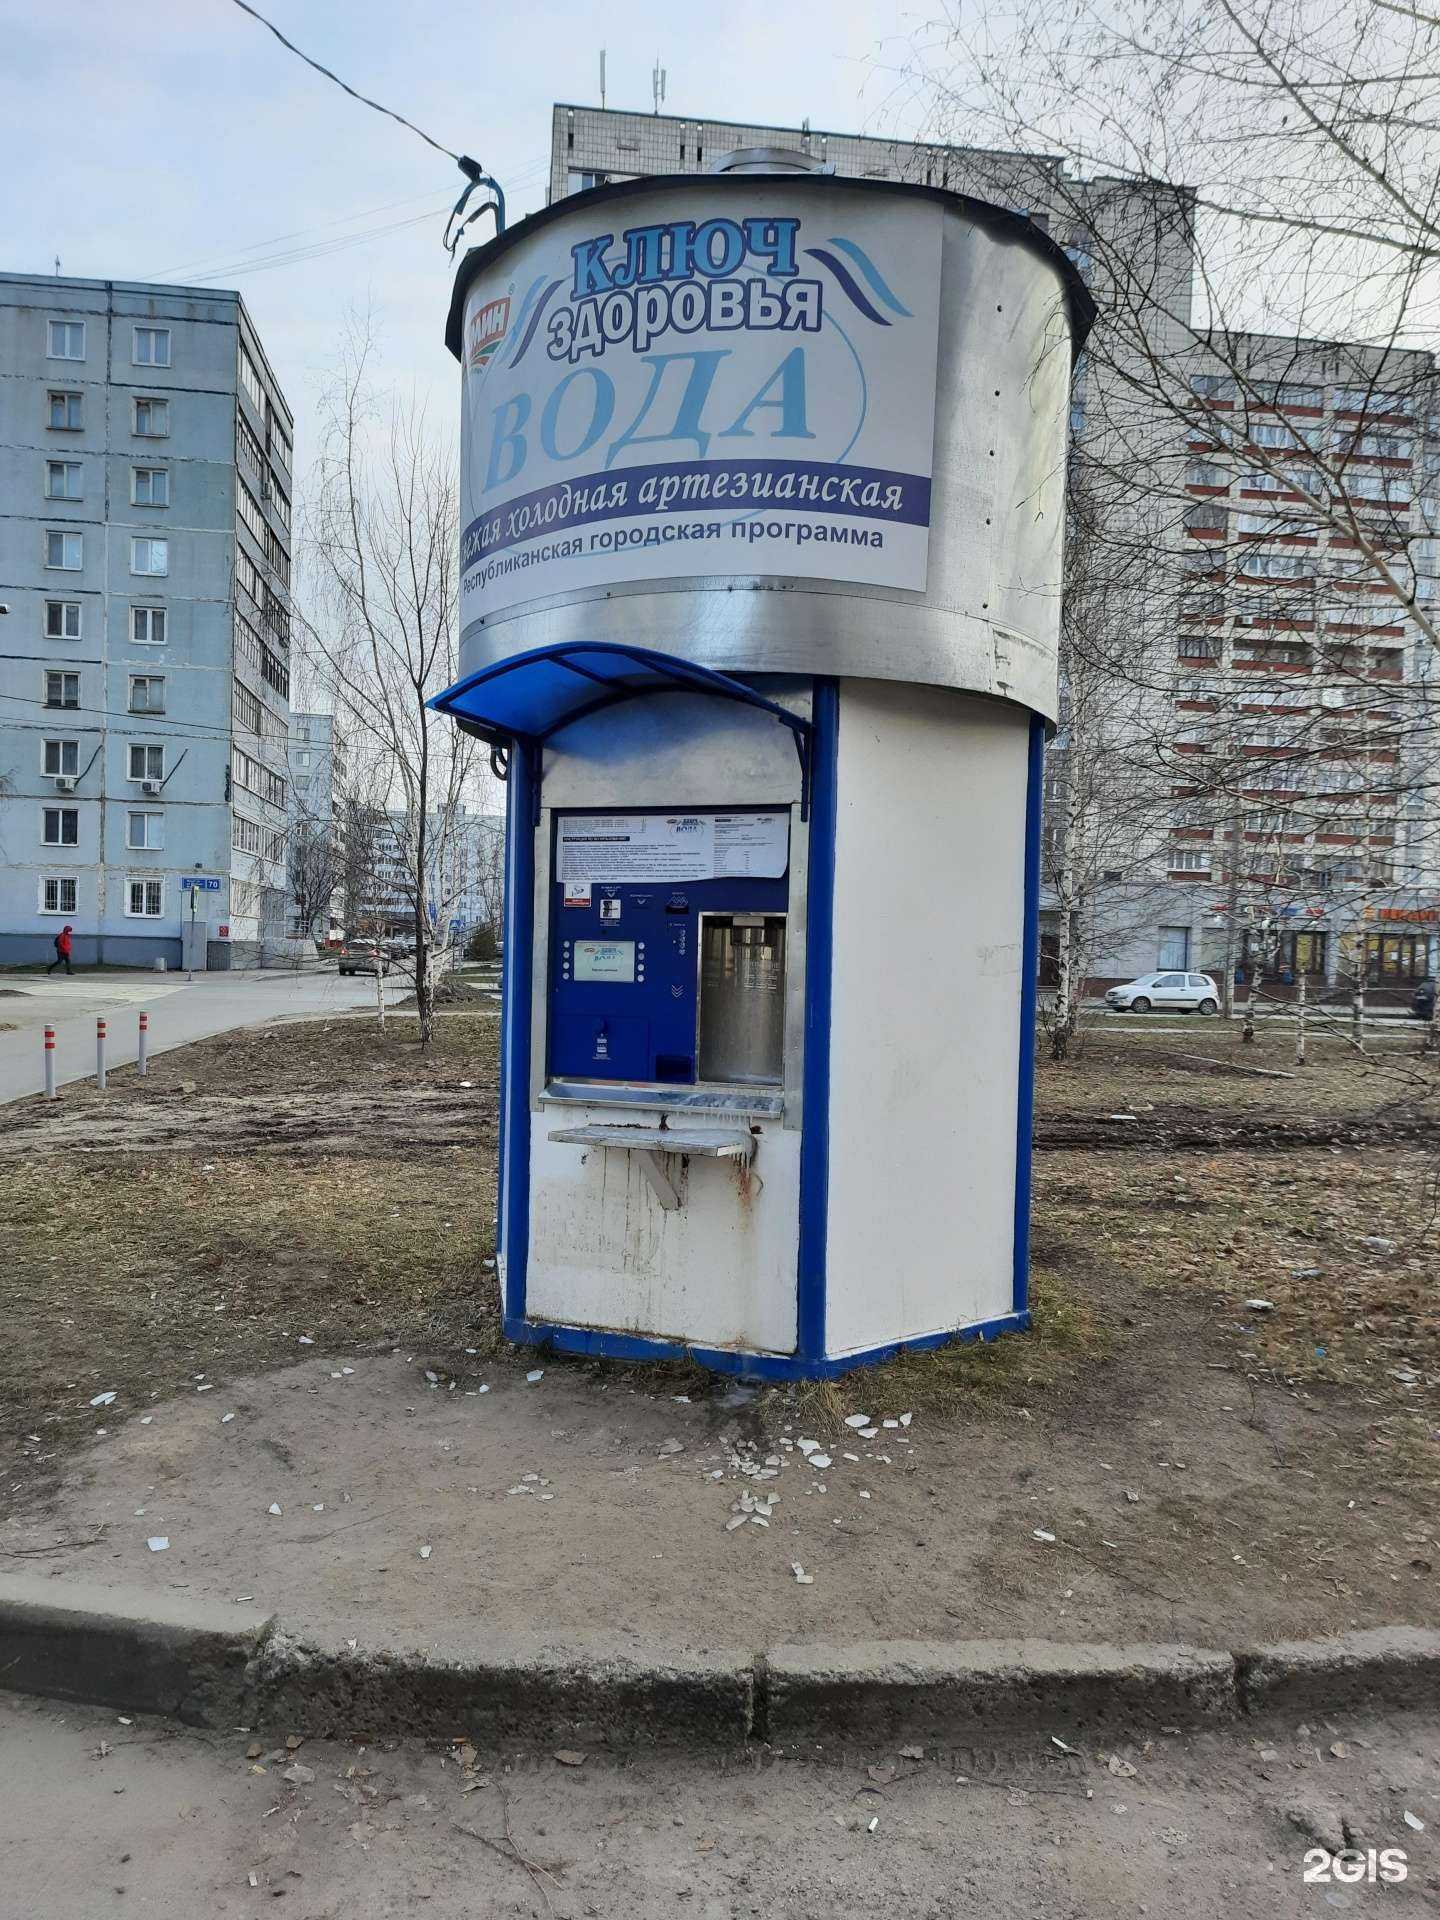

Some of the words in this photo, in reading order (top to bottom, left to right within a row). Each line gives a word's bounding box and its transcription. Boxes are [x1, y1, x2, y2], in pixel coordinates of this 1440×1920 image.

[571, 218, 801, 301] КЛЮЧ
[481, 347, 816, 494] ВОДА
[506, 482, 628, 538] холодная
[638, 472, 903, 510] артезианская
[463, 538, 583, 594] Республиканская
[590, 522, 721, 551] городская
[731, 522, 884, 548] программа
